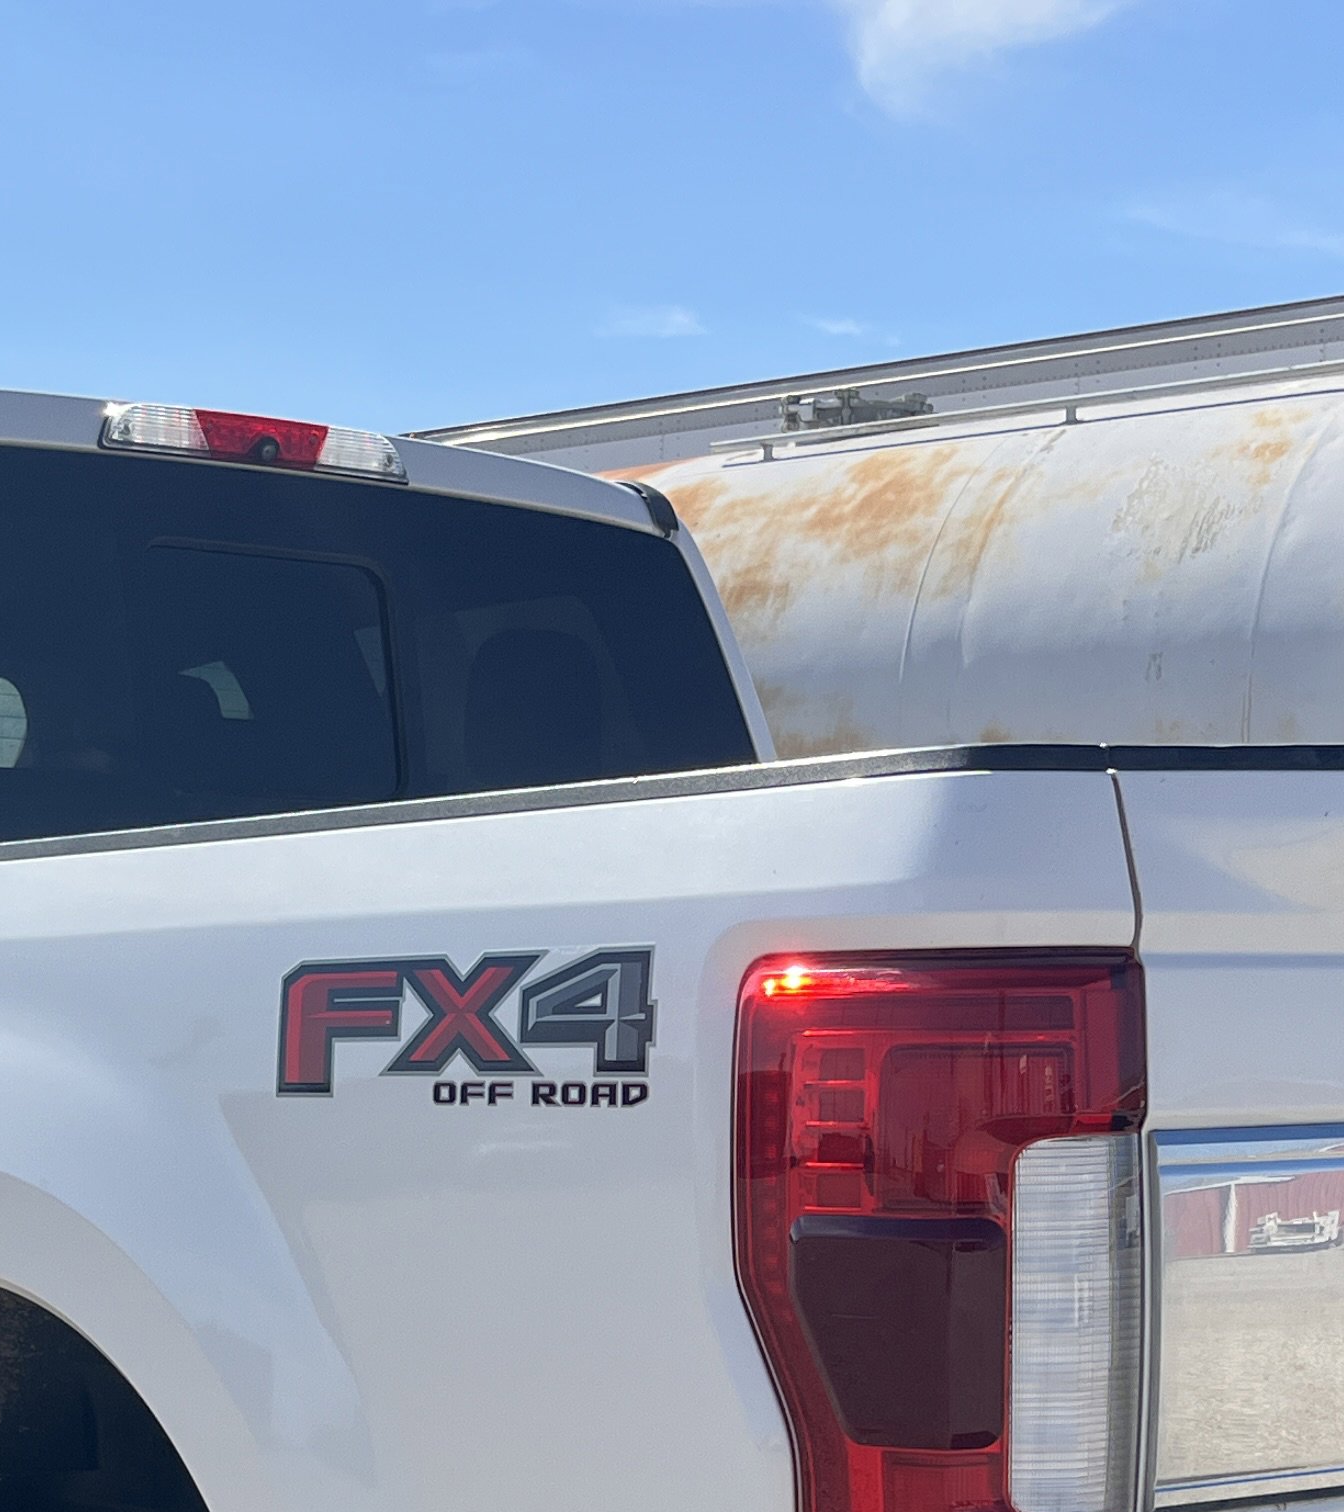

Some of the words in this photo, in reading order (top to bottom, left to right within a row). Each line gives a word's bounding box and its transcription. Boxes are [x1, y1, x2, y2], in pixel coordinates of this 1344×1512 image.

[276, 943, 657, 1098] FX4
[432, 1080, 515, 1106] OFF
[530, 1080, 649, 1108] ROAD
